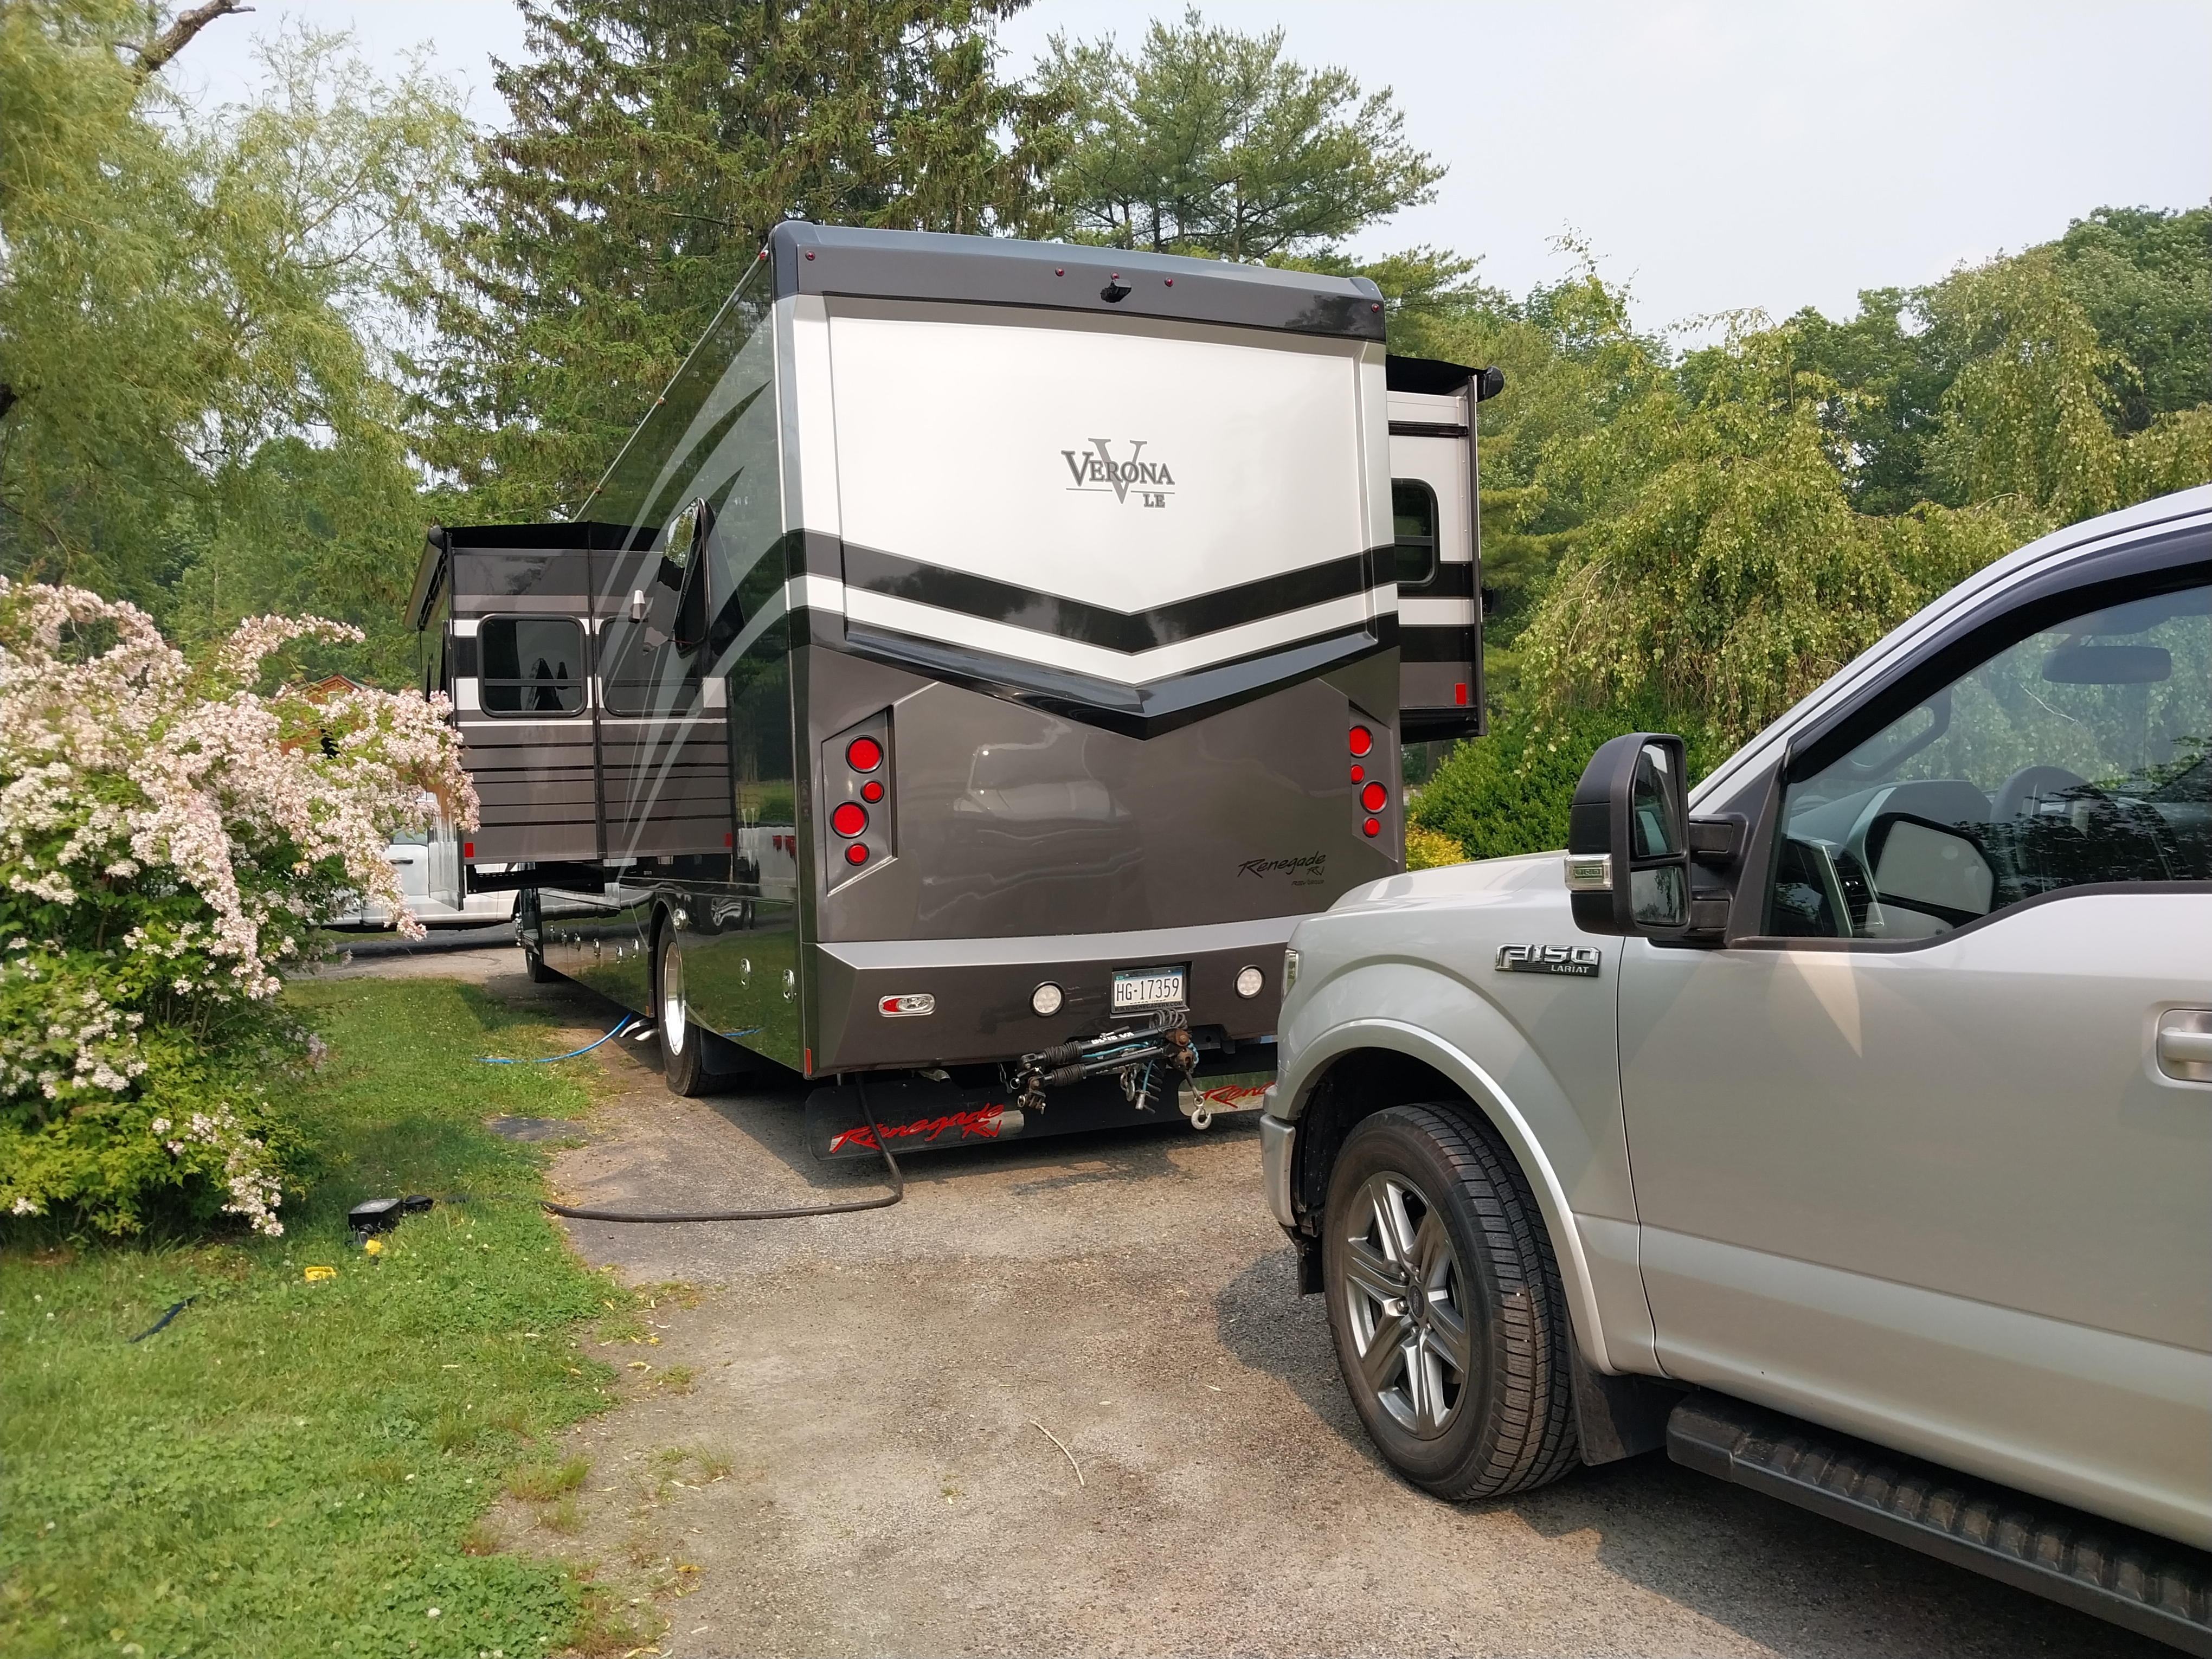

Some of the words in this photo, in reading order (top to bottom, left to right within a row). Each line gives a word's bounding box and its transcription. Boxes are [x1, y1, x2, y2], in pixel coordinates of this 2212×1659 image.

[1061, 450, 1175, 487] VERONA
[1143, 493, 1166, 508] LE
[1237, 851, 1327, 878] Renegade
[1306, 866, 1324, 876] RV
[1551, 964, 1589, 974] LARIAT
[1117, 978, 1179, 1001] HG-17359
[962, 1120, 1002, 1138] RV
